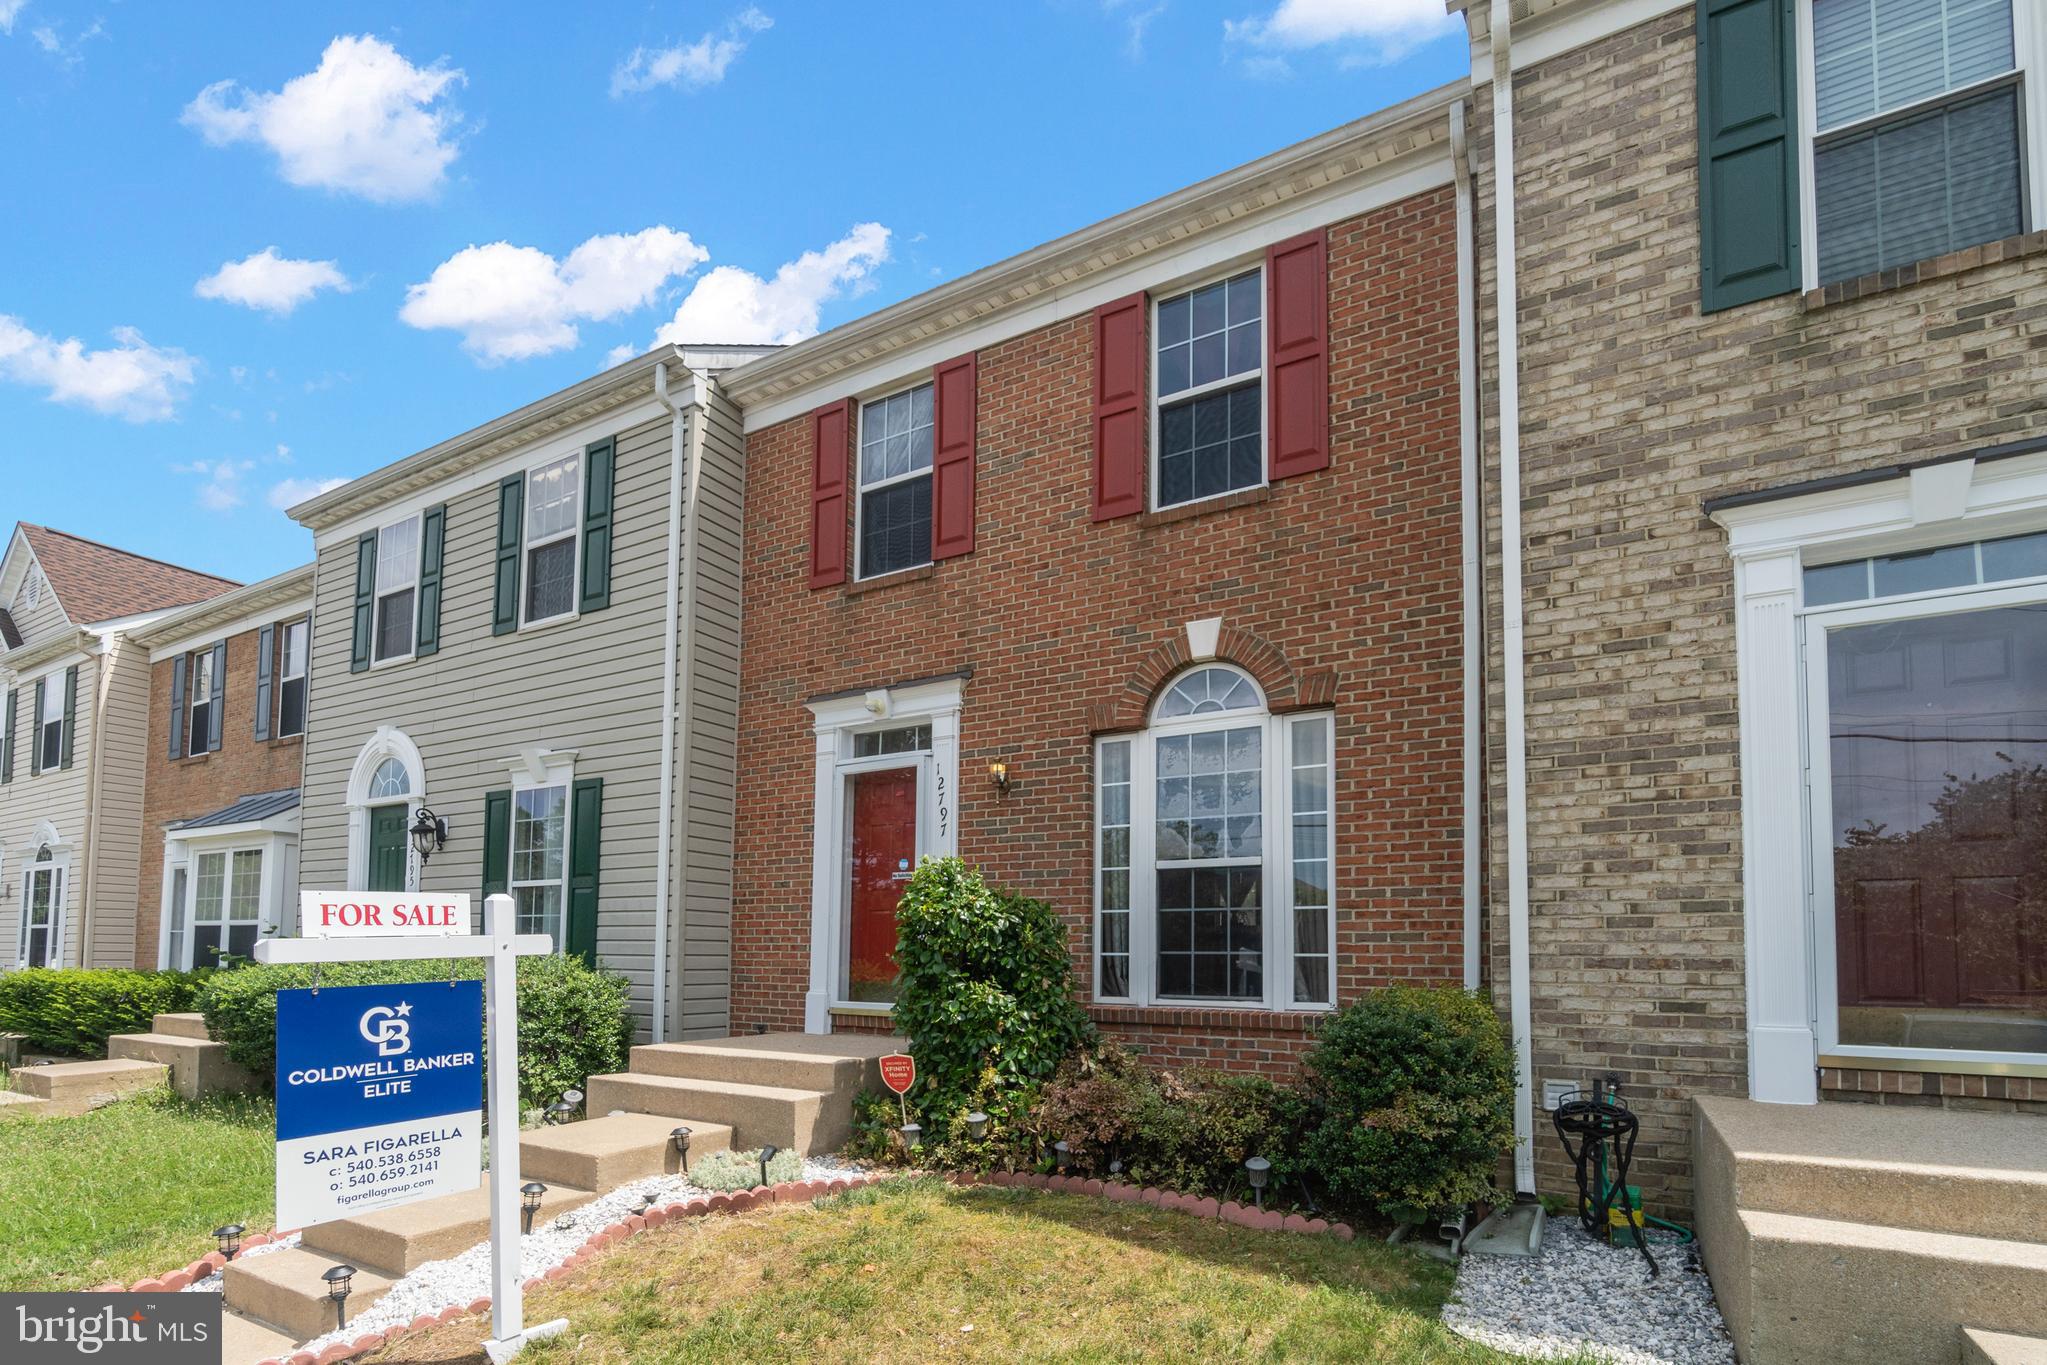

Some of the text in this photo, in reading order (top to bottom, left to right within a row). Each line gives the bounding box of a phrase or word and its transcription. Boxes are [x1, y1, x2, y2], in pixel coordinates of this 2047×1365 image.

[936, 762, 948, 837] 12797
[320, 903, 457, 927] FOR SALE
[359, 1006, 411, 1056] CB
[288, 1052, 475, 1086] COLDWELL BANKER
[364, 1080, 412, 1099] ELITE
[303, 1127, 462, 1165] SARA FIGARELLA
[329, 1146, 441, 1177] c: 540.538.6558
[330, 1160, 438, 1191] o: 540.659.2141
[337, 1178, 434, 1205] figarellagroup.com
